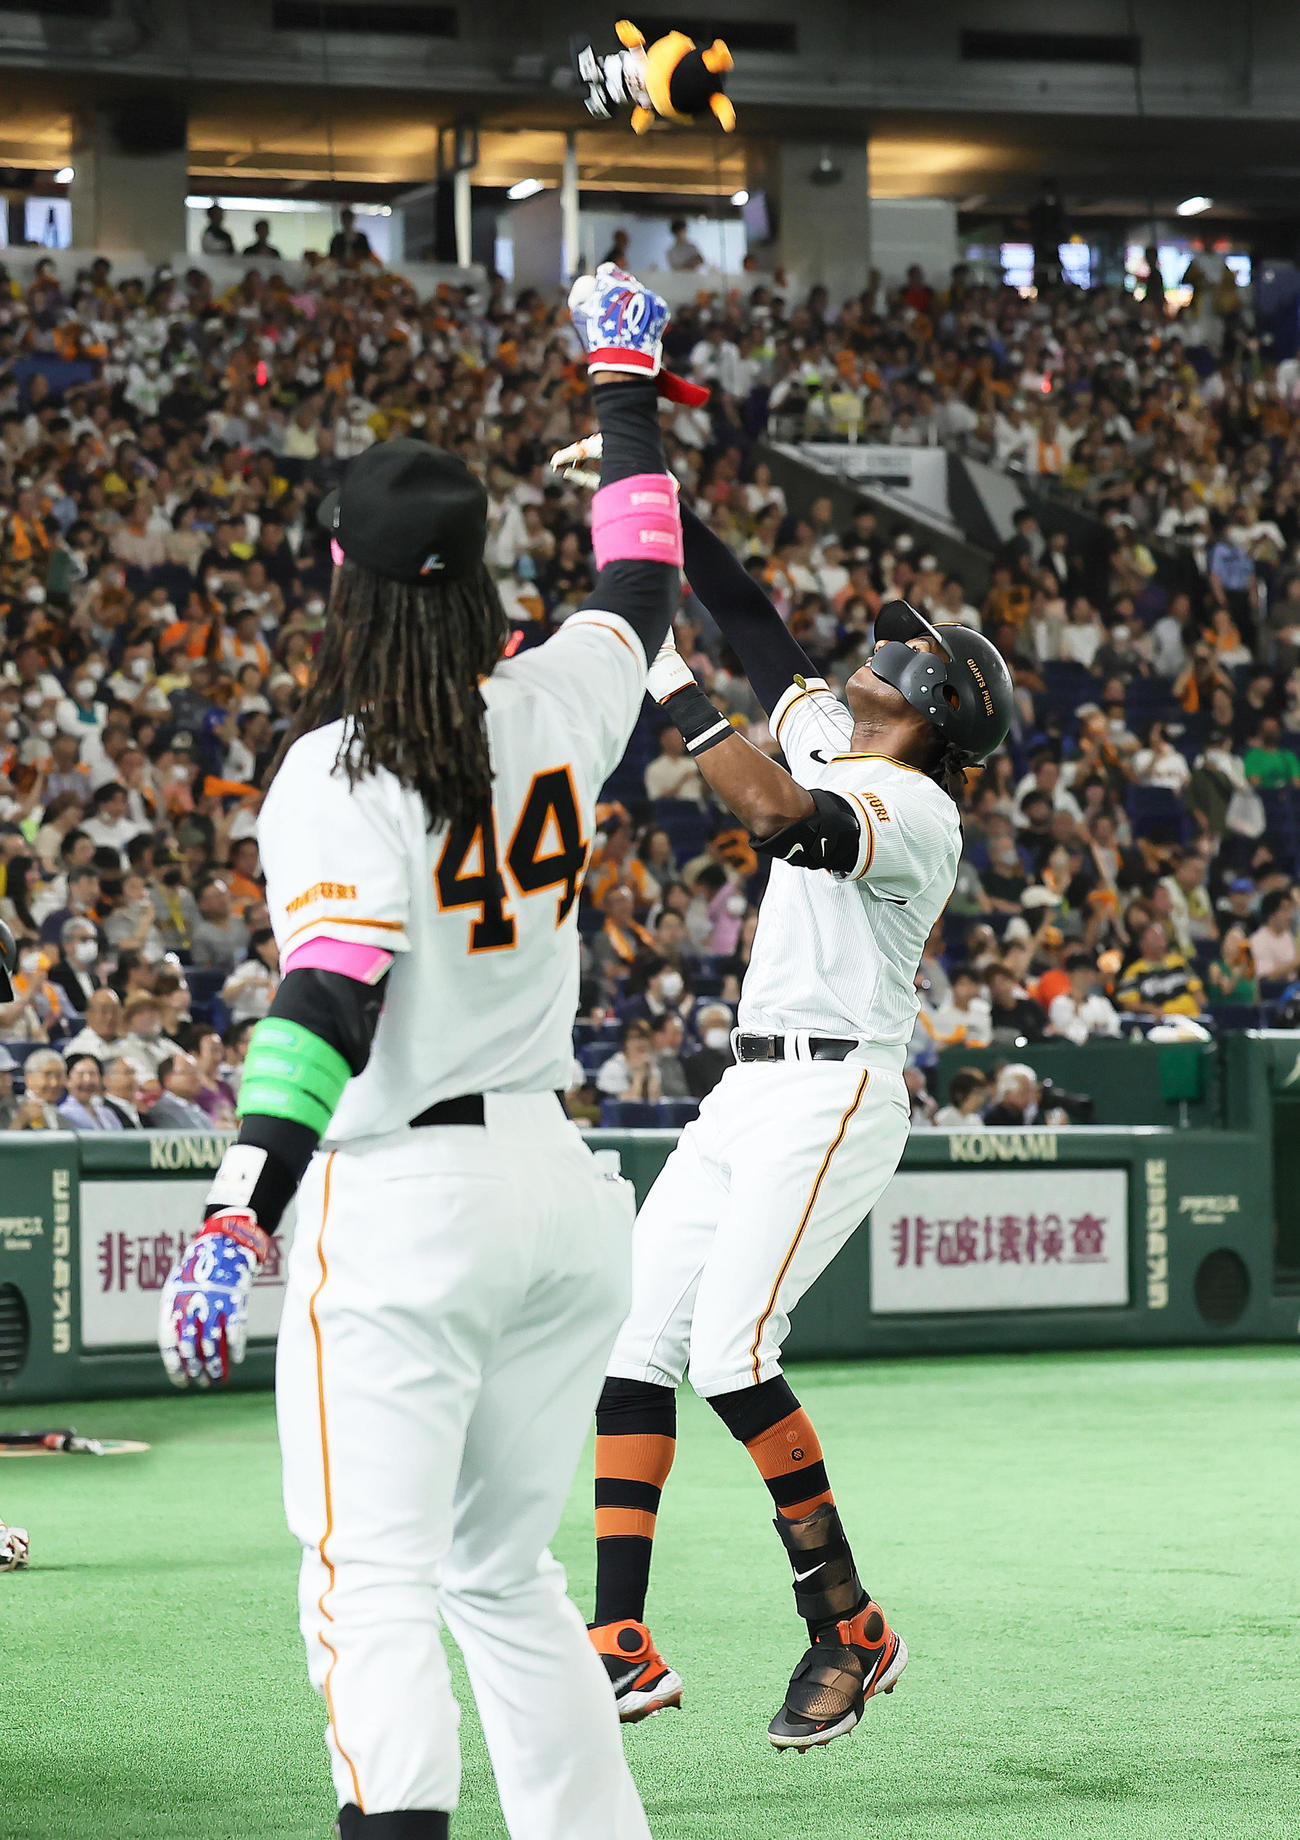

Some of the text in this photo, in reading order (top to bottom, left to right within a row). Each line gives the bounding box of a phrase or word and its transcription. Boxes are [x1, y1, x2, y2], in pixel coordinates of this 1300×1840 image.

[966, 658, 995, 716] GIANTS PRIDE
[434, 762, 592, 955] 44
[151, 1133, 238, 1169] KONA
[951, 1133, 1059, 1162] KONAMI
[891, 1213, 1109, 1267] 非破壊検査
